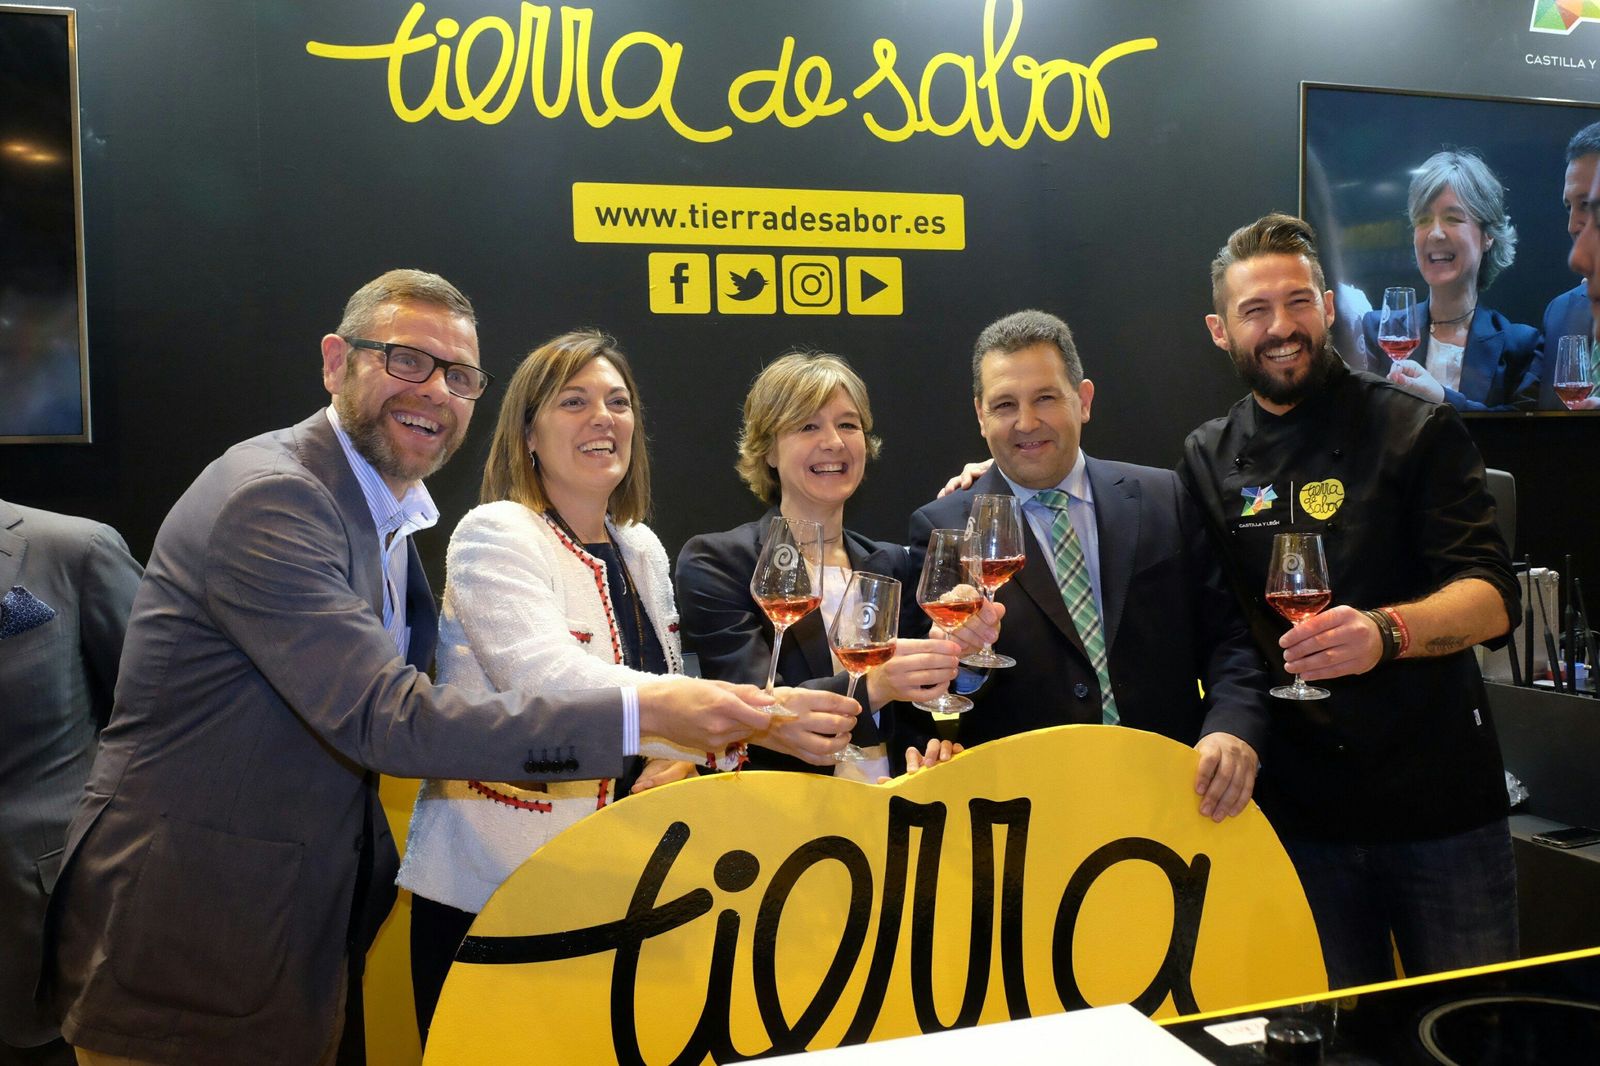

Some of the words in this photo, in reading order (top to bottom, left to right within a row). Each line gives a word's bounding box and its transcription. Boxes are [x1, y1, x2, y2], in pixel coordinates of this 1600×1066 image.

[306, 2, 733, 144] tierra
[728, 36, 848, 129] de
[853, 0, 1158, 150] sabor
[1525, 53, 1586, 69] CASTILLA
[1588, 59, 1597, 70] Y
[595, 203, 946, 235] www.tierradesabor.es
[455, 796, 1212, 1066] tierra
